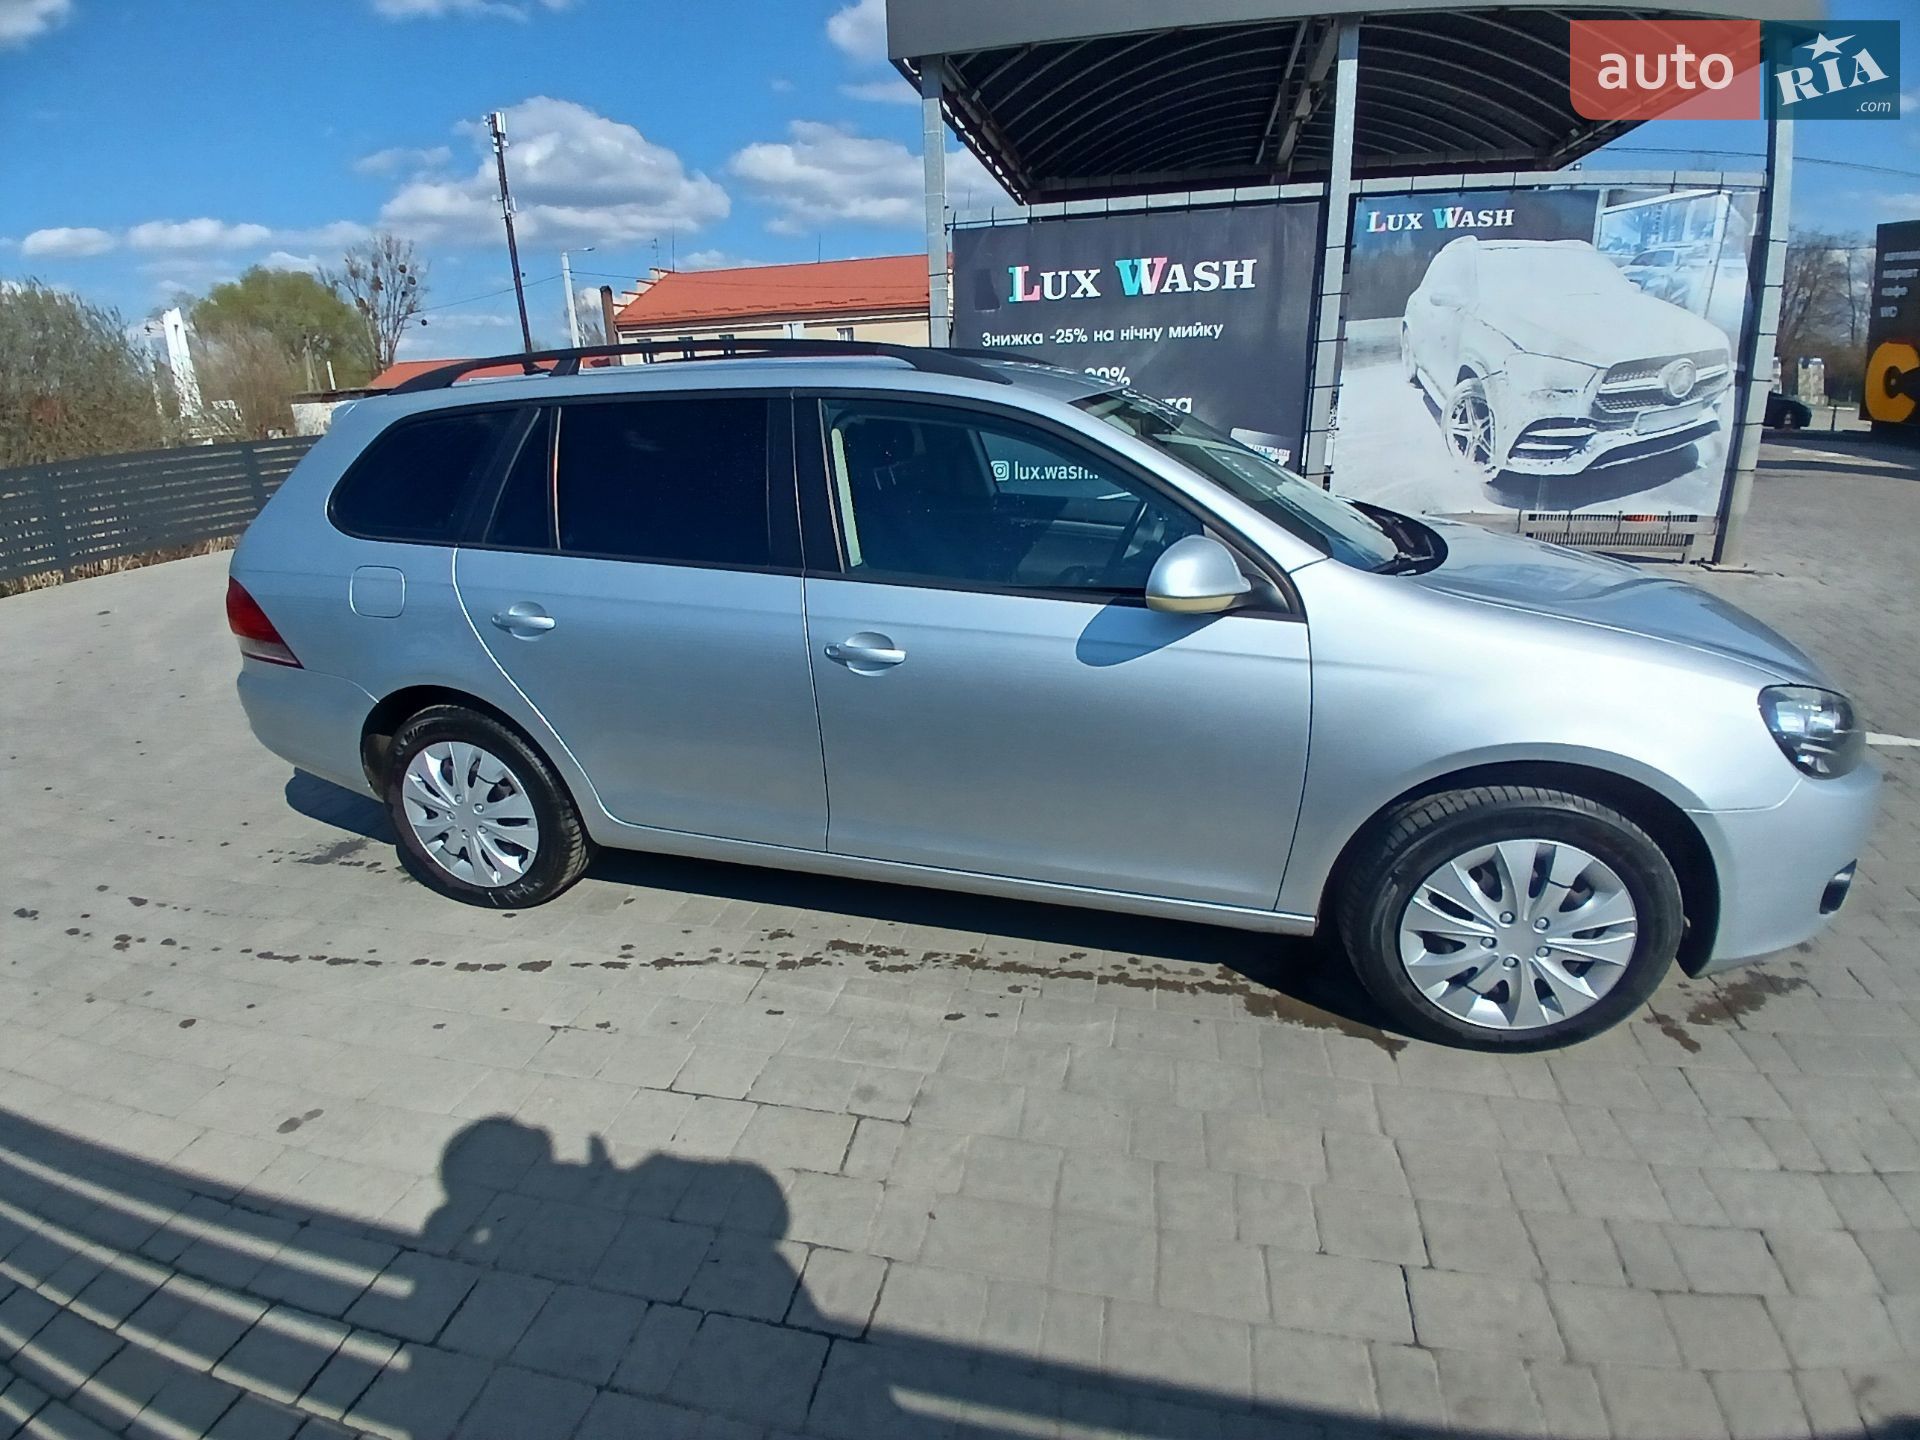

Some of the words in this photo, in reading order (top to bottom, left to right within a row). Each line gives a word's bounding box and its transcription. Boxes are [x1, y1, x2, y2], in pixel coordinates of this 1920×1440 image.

[1366, 211, 1424, 233] LUX
[1432, 206, 1515, 229] WASH
[1008, 265, 1101, 302] LUX
[1115, 256, 1257, 296] WASH
[982, 331, 1044, 347] Знижка
[1049, 328, 1088, 344] -25%
[1093, 329, 1114, 342] на
[1120, 325, 1163, 343] нічну
[1168, 322, 1224, 339] мийку
